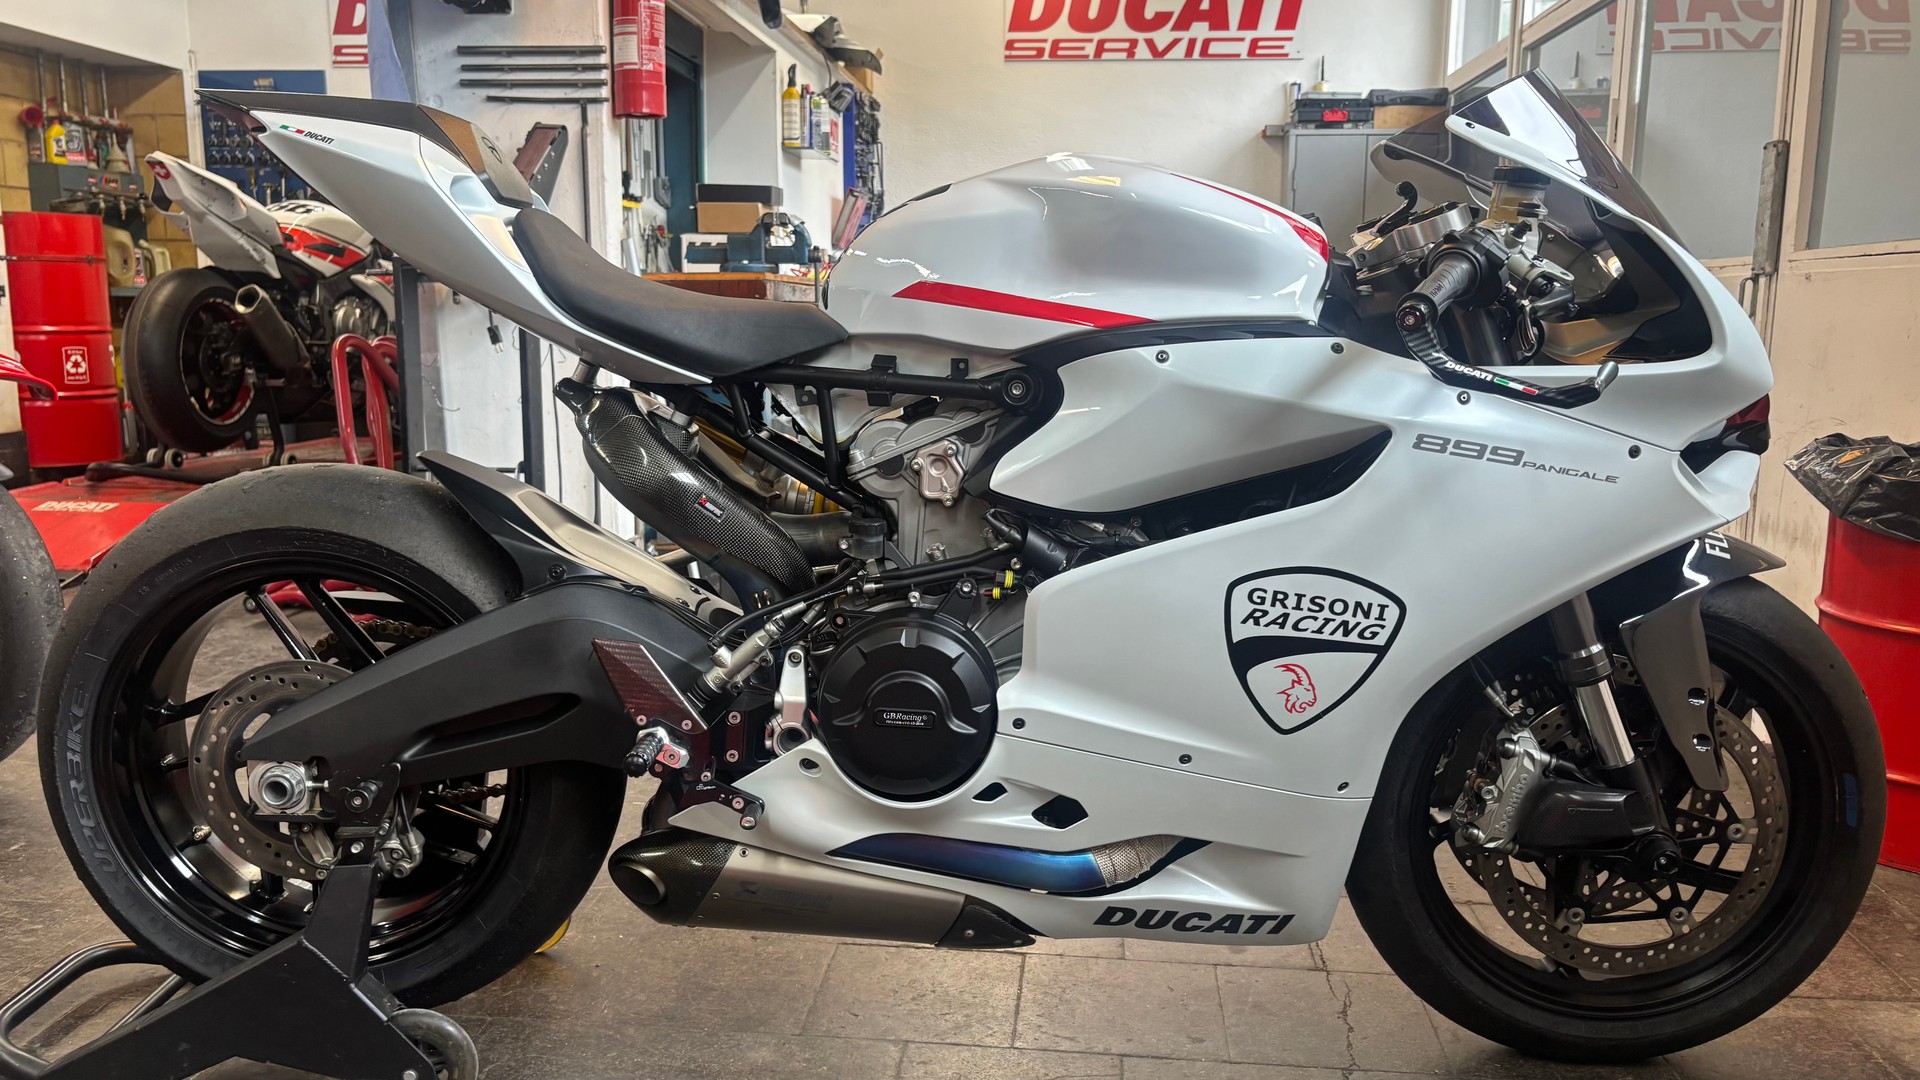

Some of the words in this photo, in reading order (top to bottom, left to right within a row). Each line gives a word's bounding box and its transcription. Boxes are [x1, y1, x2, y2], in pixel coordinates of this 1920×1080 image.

[1004, 37, 1293, 59] SERVICE
[304, 131, 335, 145] DUCATI
[1445, 361, 1494, 381] DUCATI
[1412, 433, 1525, 466] 899
[1522, 461, 1620, 484] PANIGALE
[31, 501, 120, 512] DUCATI
[1247, 587, 1389, 621] GRISONI
[1240, 608, 1386, 640] RACING
[66, 686, 118, 873] UPERBIKE
[1495, 774, 1529, 832] brembo
[1093, 906, 1296, 935] DUCATI
